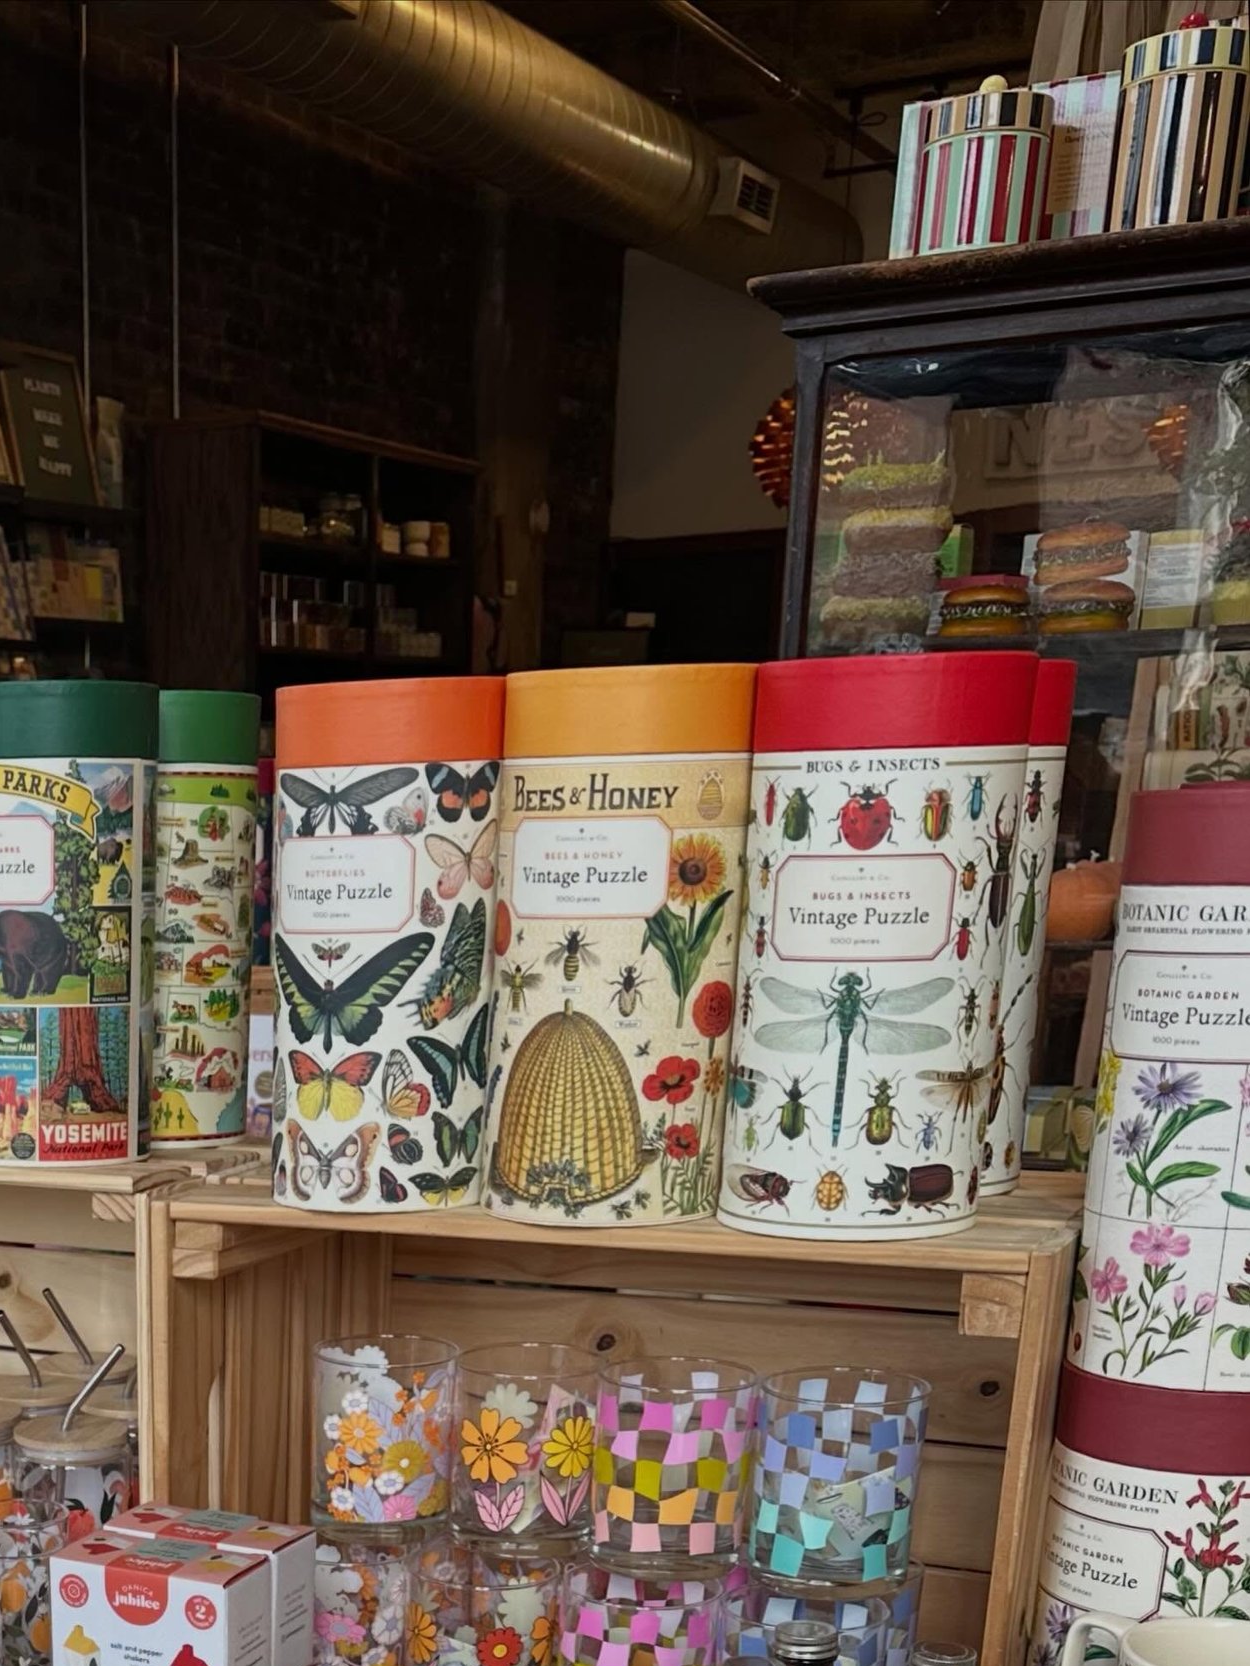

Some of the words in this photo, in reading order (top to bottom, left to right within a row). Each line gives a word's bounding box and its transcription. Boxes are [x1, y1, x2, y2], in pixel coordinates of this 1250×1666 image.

[807, 760, 843, 773] BUGS
[849, 760, 860, 772] &
[868, 757, 941, 772] INSECTS
[2, 769, 70, 804] PARKS
[513, 774, 566, 812] BEES
[569, 786, 586, 806] &
[588, 772, 680, 811] HONEY
[544, 852, 570, 861] BEES
[584, 850, 624, 860] HONEY
[305, 869, 366, 879] BUTTERFLIES
[523, 866, 580, 886] Vintage
[585, 865, 649, 884] Puzzle
[287, 884, 332, 902] Vintage
[337, 883, 393, 900] Puzzle
[860, 892, 911, 900] INSECTS
[789, 907, 858, 929] Vintage
[865, 906, 930, 925] Puzzle
[1122, 903, 1190, 922] BOTANIC
[1199, 904, 1250, 922] GAR
[830, 937, 852, 945] 1000
[853, 938, 880, 946] pieces
[1138, 988, 1182, 999] BOTANIC
[1187, 990, 1240, 1000] GARDEN
[1122, 1003, 1180, 1029] Vintage
[1185, 1006, 1250, 1026] Puzzle
[19, 1042, 36, 1051] PARK
[40, 1122, 128, 1146] YOSEMITE
[101, 1142, 125, 1153] Park
[1093, 1476, 1179, 1505] GARDEN
[1129, 1504, 1160, 1515] PLANTS
[1052, 1533, 1081, 1552] BOTANIC
[1083, 1547, 1124, 1565] GARDEN
[1080, 1561, 1139, 1590] Puzzle
[122, 1584, 154, 1598] DANICA
[112, 1591, 161, 1611] jubilee
[194, 1603, 208, 1620] 2
